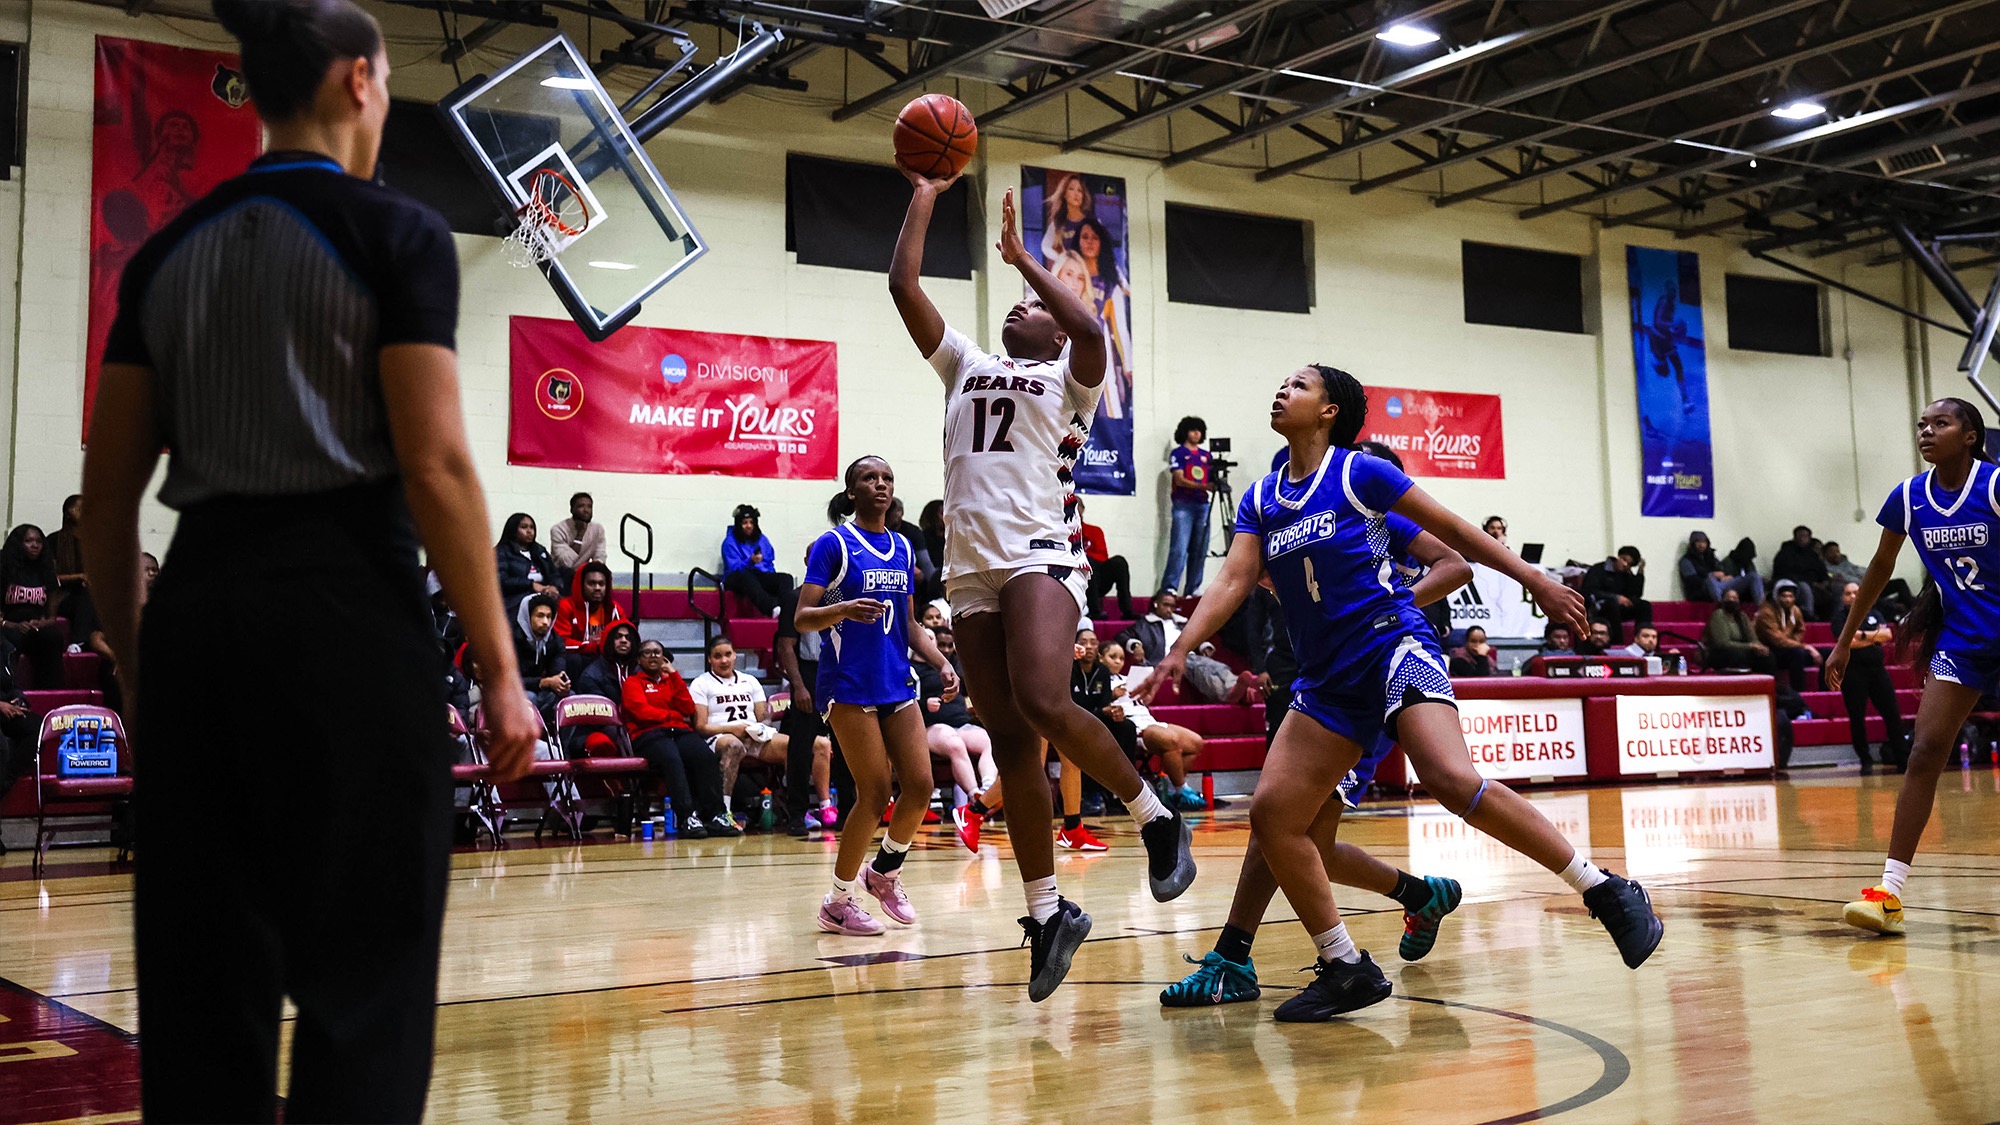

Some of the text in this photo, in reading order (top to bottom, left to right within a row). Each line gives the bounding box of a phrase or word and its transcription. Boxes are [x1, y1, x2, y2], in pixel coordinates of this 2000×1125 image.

[697, 362, 789, 383] DIVISION II
[961, 375, 1046, 397] BEARS
[629, 393, 816, 441] MAKE IT YOURS
[971, 397, 1016, 453] 12
[1411, 436, 1425, 451] IT
[1424, 424, 1481, 460] YOURS
[1082, 444, 1119, 466] YOURS
[1270, 512, 1334, 557] BOBCATS
[1923, 525, 1986, 549] BOBCATS
[865, 571, 908, 591] BOBCATS
[1303, 556, 1321, 603] 4
[1944, 556, 1986, 591] 12
[882, 599, 895, 635] 0
[1450, 606, 1491, 619] adidas
[716, 694, 751, 705] BEARS
[725, 705, 748, 722] 23
[1461, 713, 1558, 735] OOMFIELD
[1638, 709, 1746, 730] BLOOMFIELD
[1512, 741, 1576, 762] BEARS
[1626, 735, 1763, 758] COLLEGE BEARS
[762, 799, 771, 810] G
